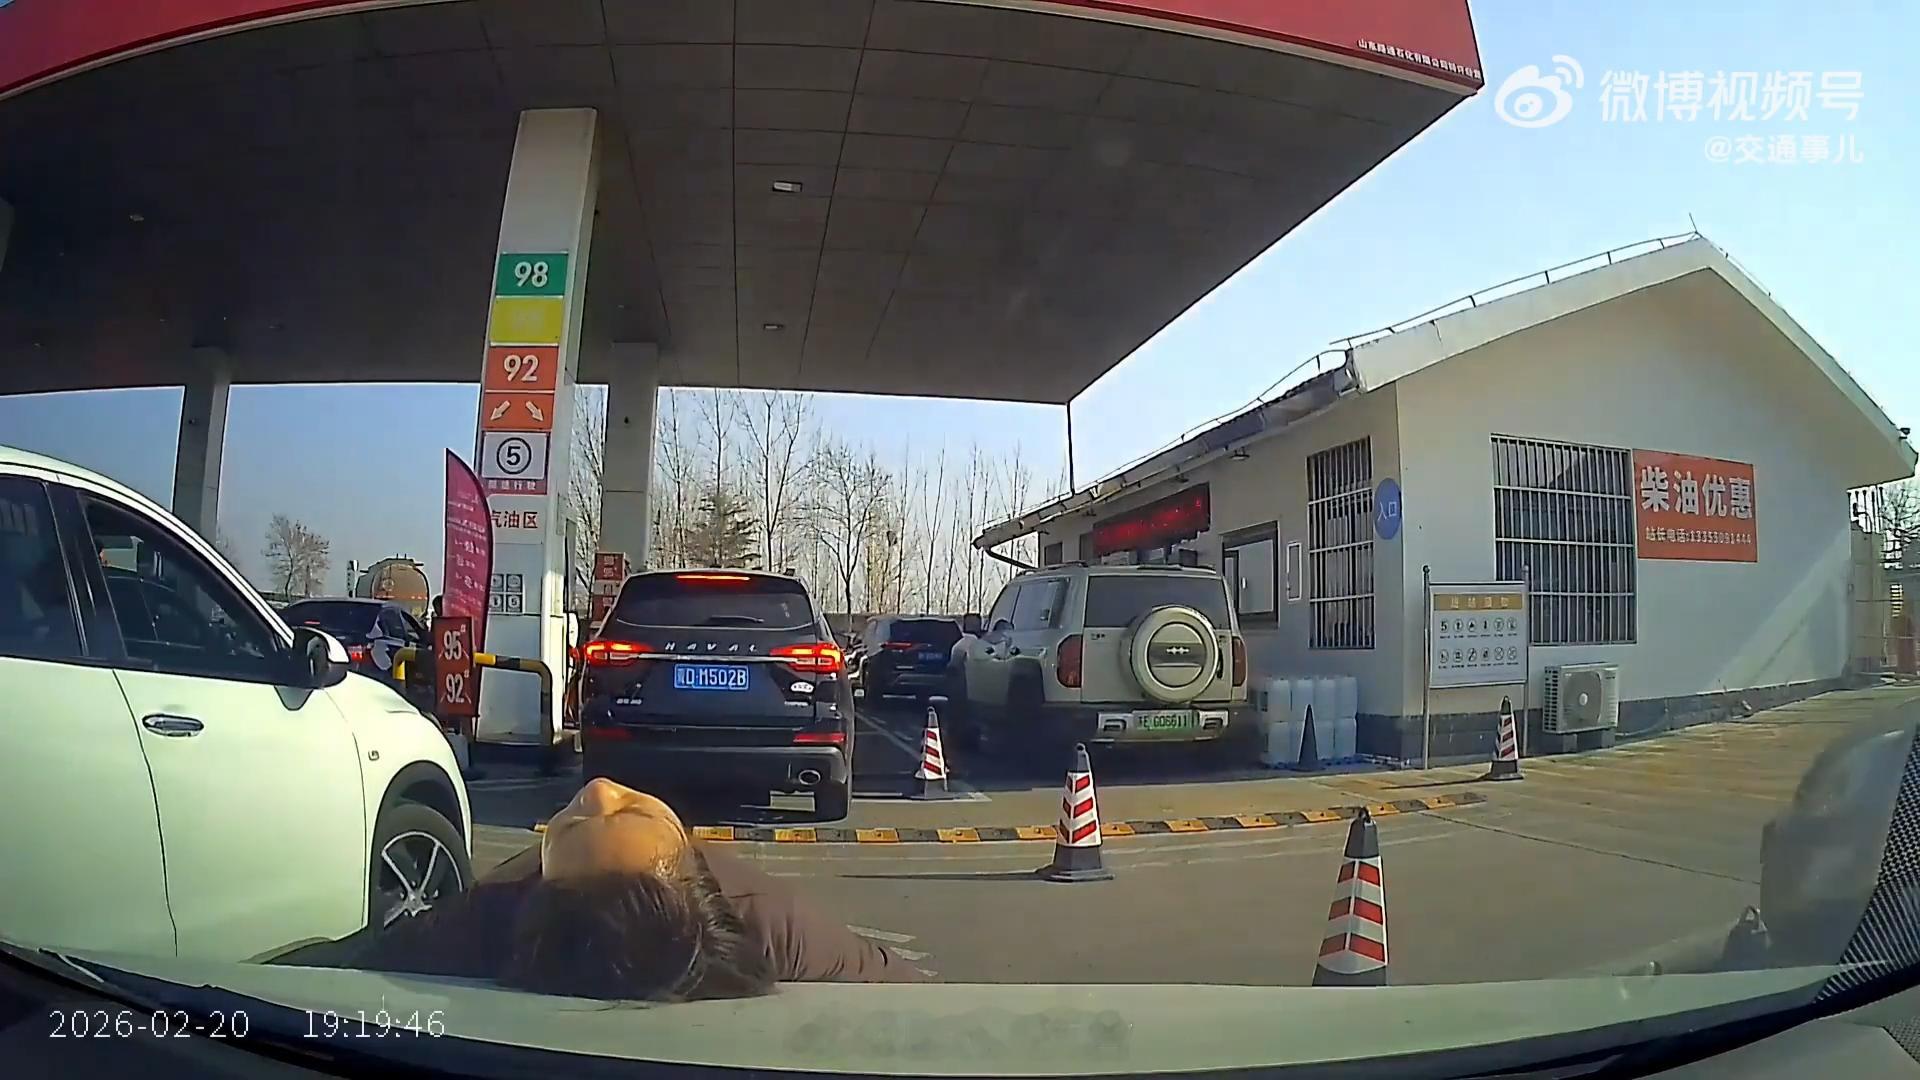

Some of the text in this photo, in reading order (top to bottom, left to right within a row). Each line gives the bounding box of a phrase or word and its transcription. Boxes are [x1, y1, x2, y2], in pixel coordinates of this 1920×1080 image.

[514, 261, 549, 287] 98
[503, 354, 539, 382] 92
[506, 445, 521, 466] 5
[1640, 465, 1753, 519] 柴油优惠
[1377, 501, 1397, 521] 入口
[665, 641, 758, 651] HAVAL
